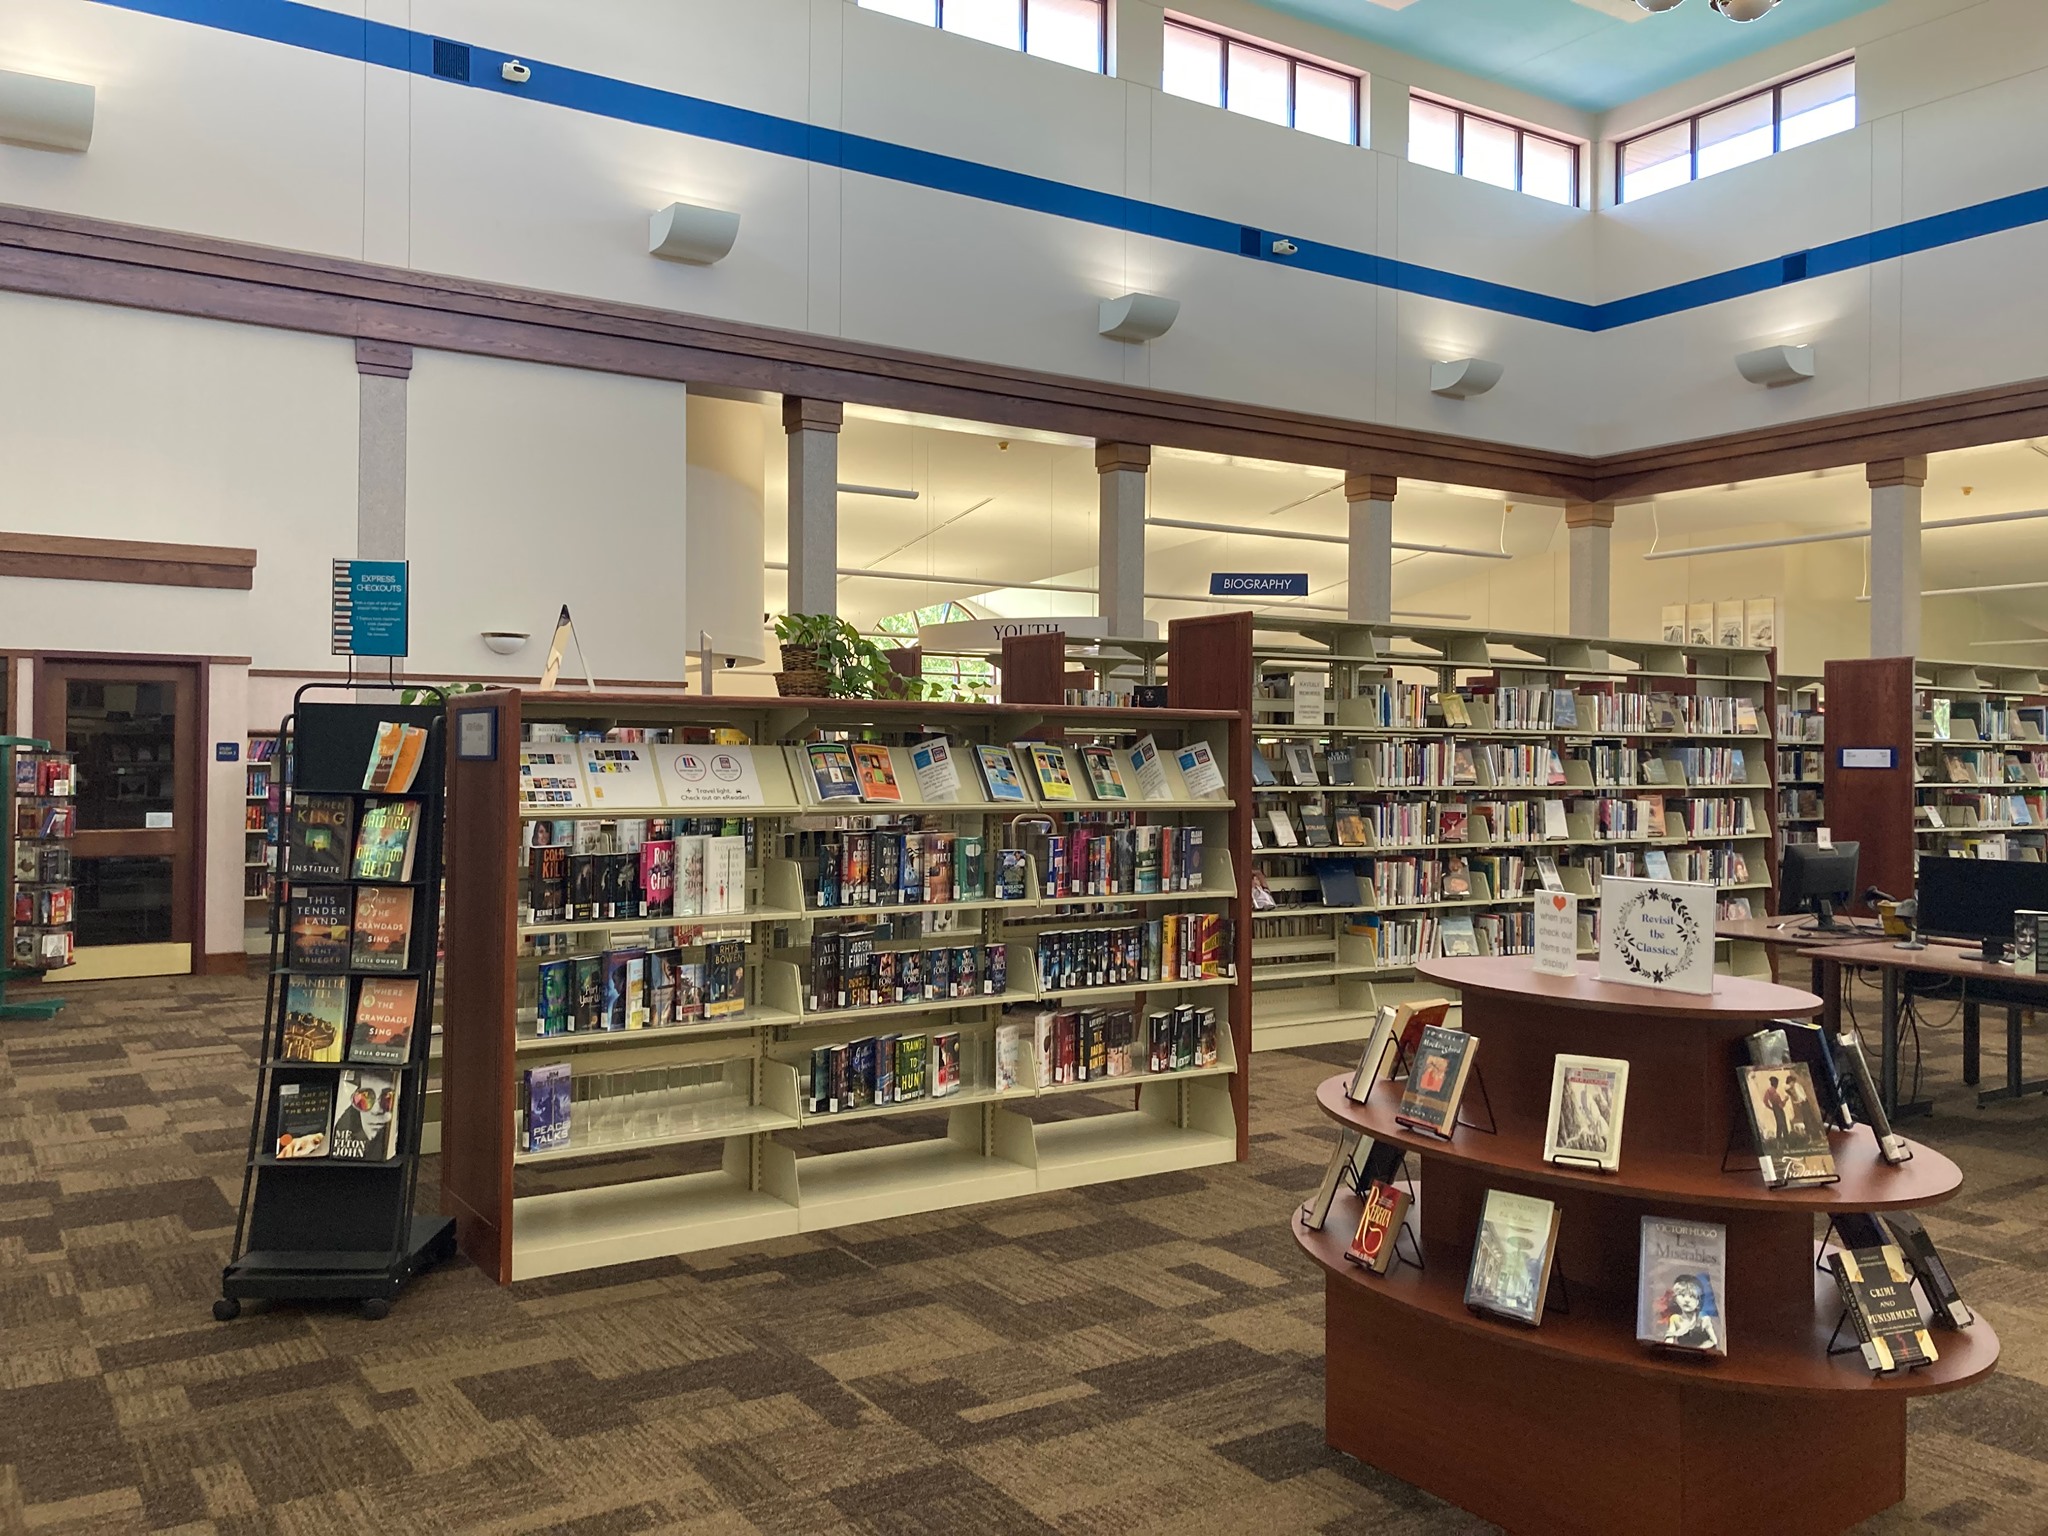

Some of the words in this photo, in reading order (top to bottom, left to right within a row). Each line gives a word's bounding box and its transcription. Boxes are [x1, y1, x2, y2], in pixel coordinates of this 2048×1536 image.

[361, 574, 396, 583] EXPRESS
[1223, 578, 1292, 590] BIOGRAPHY
[356, 584, 402, 592] CHECKOUTS
[993, 624, 1059, 641] YOUTH
[297, 810, 345, 825] KING
[292, 864, 340, 874] INSTITUTE
[308, 896, 336, 904] THIS
[1539, 895, 1551, 905] We
[297, 906, 346, 915] TENDER
[304, 917, 338, 925] LAND
[1540, 913, 1558, 921] when
[1560, 916, 1573, 925] you
[1642, 913, 1674, 925] Revisit
[357, 921, 404, 931] CRAWDADS
[367, 935, 390, 943] SING
[1539, 927, 1559, 937] check
[1561, 931, 1573, 940] out
[1650, 929, 1665, 939] the
[719, 943, 739, 953] RHYS
[1561, 947, 1571, 955] on
[1636, 942, 1679, 956] Classics!
[715, 953, 743, 965] BOWEN
[1541, 958, 1569, 970] display!
[373, 987, 403, 997] WHERE
[377, 1001, 394, 1009] THE
[359, 1013, 408, 1024] CRAWDADS
[369, 1028, 392, 1036] SING
[1438, 1033, 1456, 1042] KILL
[1423, 1039, 1462, 1054] Mockingbird
[910, 1057, 918, 1068] TO
[901, 1070, 925, 1091] HUNT
[533, 1120, 571, 1136] PEACE
[335, 1129, 352, 1140] ME
[534, 1130, 569, 1145] TALKS
[334, 1138, 366, 1149] ELTON
[332, 1146, 365, 1158] JOHN
[1781, 1156, 1827, 1180] Twain
[1655, 1223, 1688, 1235] VICTOR
[1689, 1227, 1718, 1238] HUGO
[1676, 1234, 1697, 1249] Les
[1869, 1286, 1897, 1298] CRIME
[1880, 1300, 1896, 1308] AND
[1867, 1308, 1918, 1325] PUNISHMENT
